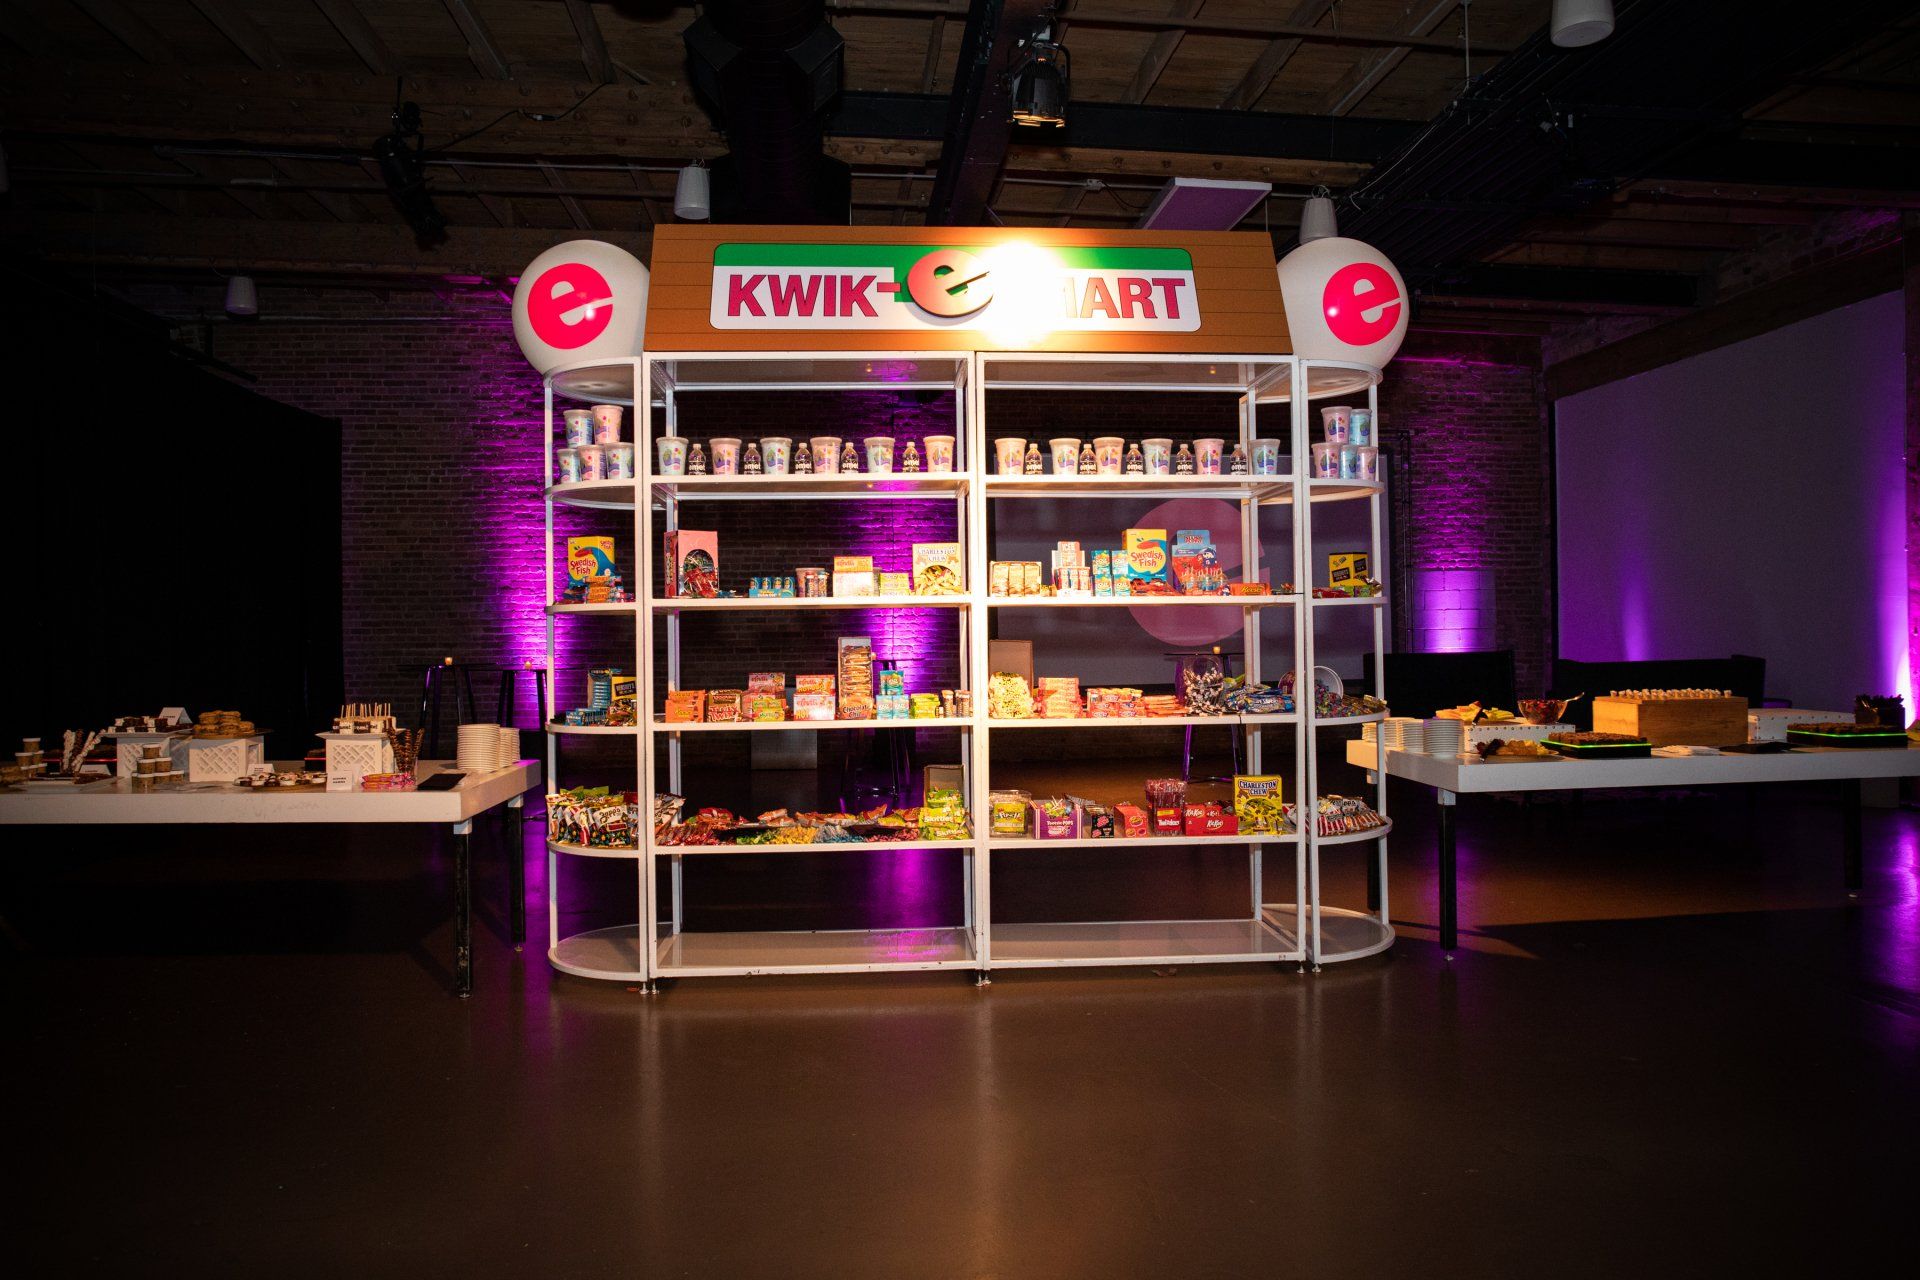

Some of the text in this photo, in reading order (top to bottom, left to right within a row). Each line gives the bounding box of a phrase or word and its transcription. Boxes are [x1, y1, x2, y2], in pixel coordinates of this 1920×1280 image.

[727, 273, 902, 318] KWIK-
[527, 262, 614, 350] e
[1322, 262, 1402, 347] e
[1131, 550, 1163, 562] Swedish
[1139, 557, 1158, 567] Fish
[570, 558, 596, 571] Swedish
[576, 566, 591, 575] Fish
[1239, 779, 1277, 790] CHARLESTON
[1250, 788, 1268, 796] CHEW
